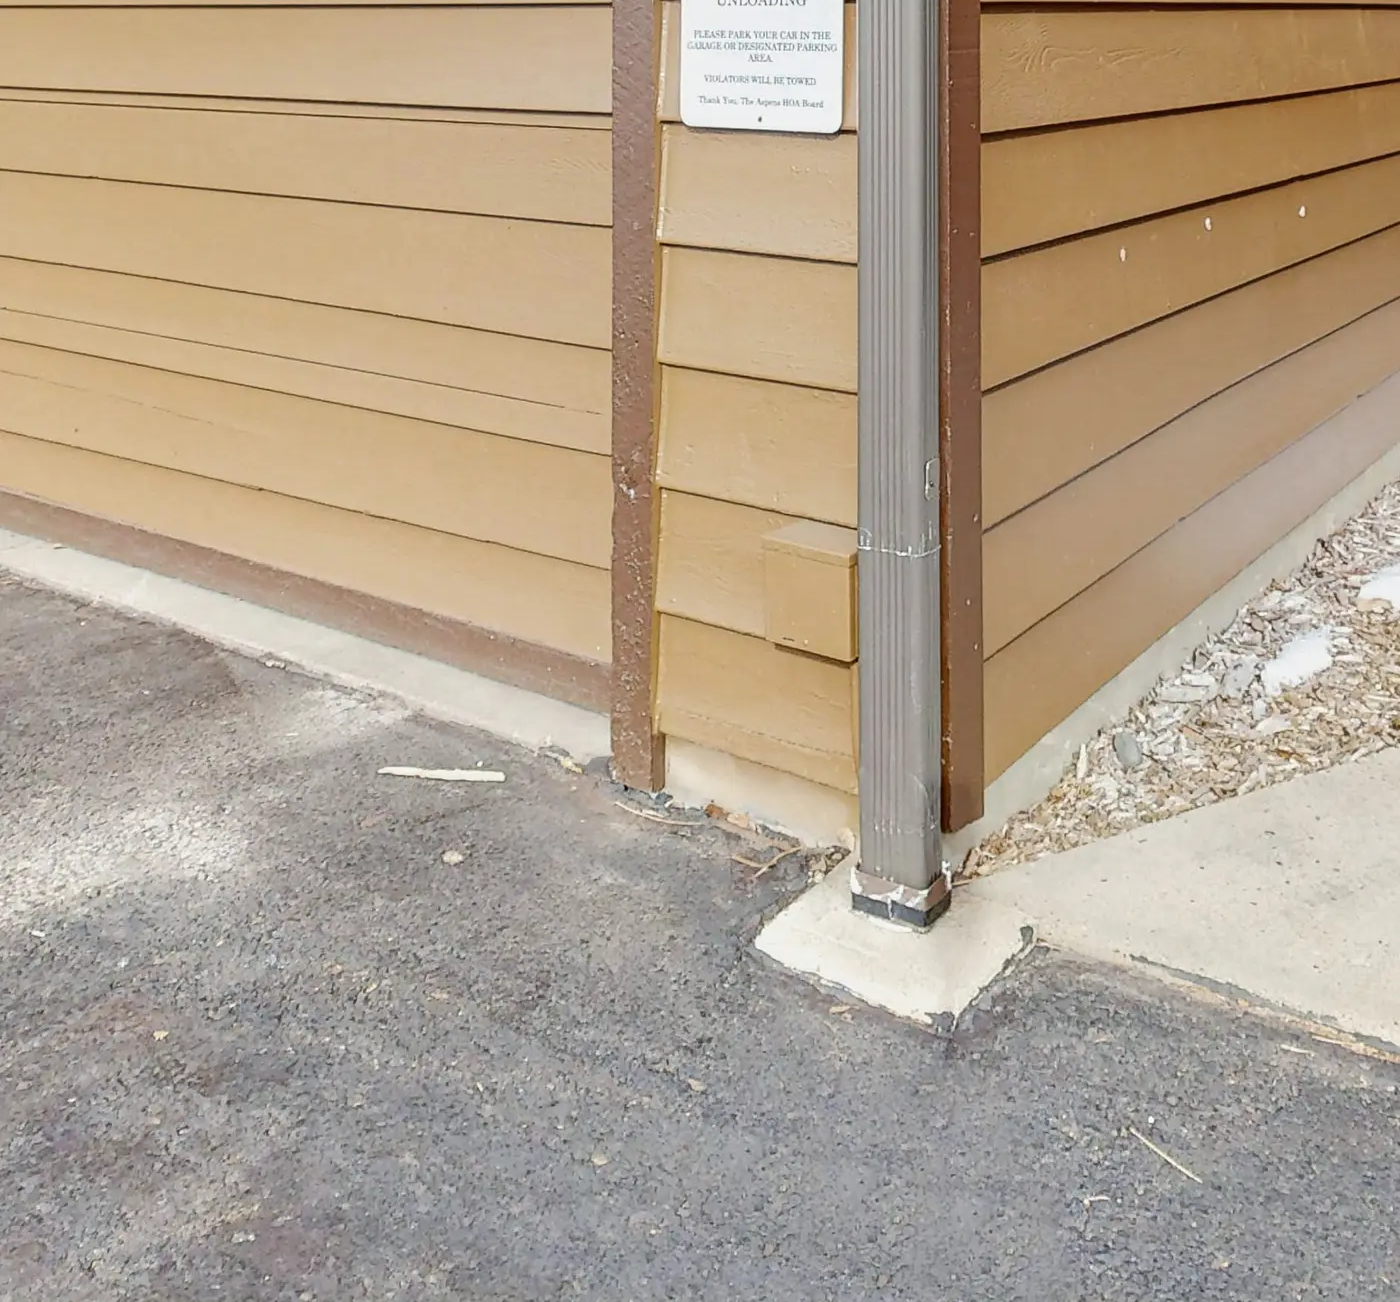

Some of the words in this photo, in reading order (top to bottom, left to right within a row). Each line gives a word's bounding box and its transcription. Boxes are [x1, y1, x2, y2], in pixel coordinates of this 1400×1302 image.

[694, 30, 727, 39] PLEASE
[728, 30, 751, 39] PARK
[753, 30, 778, 40] YOUR
[779, 31, 798, 40] CAR
[800, 31, 810, 40] IN
[812, 31, 831, 40] THE
[687, 41, 722, 50] GARAGE
[724, 42, 736, 50] OR
[738, 42, 795, 52] DESIGNATED
[797, 43, 838, 52] PARKING
[704, 74, 750, 84] VIOLATORS
[751, 75, 772, 85] WILL
[774, 76, 785, 85] BE
[787, 77, 817, 86] TOWED
[698, 95, 721, 104] Thank
[740, 97, 754, 105] The
[783, 98, 800, 107] HOA
[802, 99, 824, 109] Board
